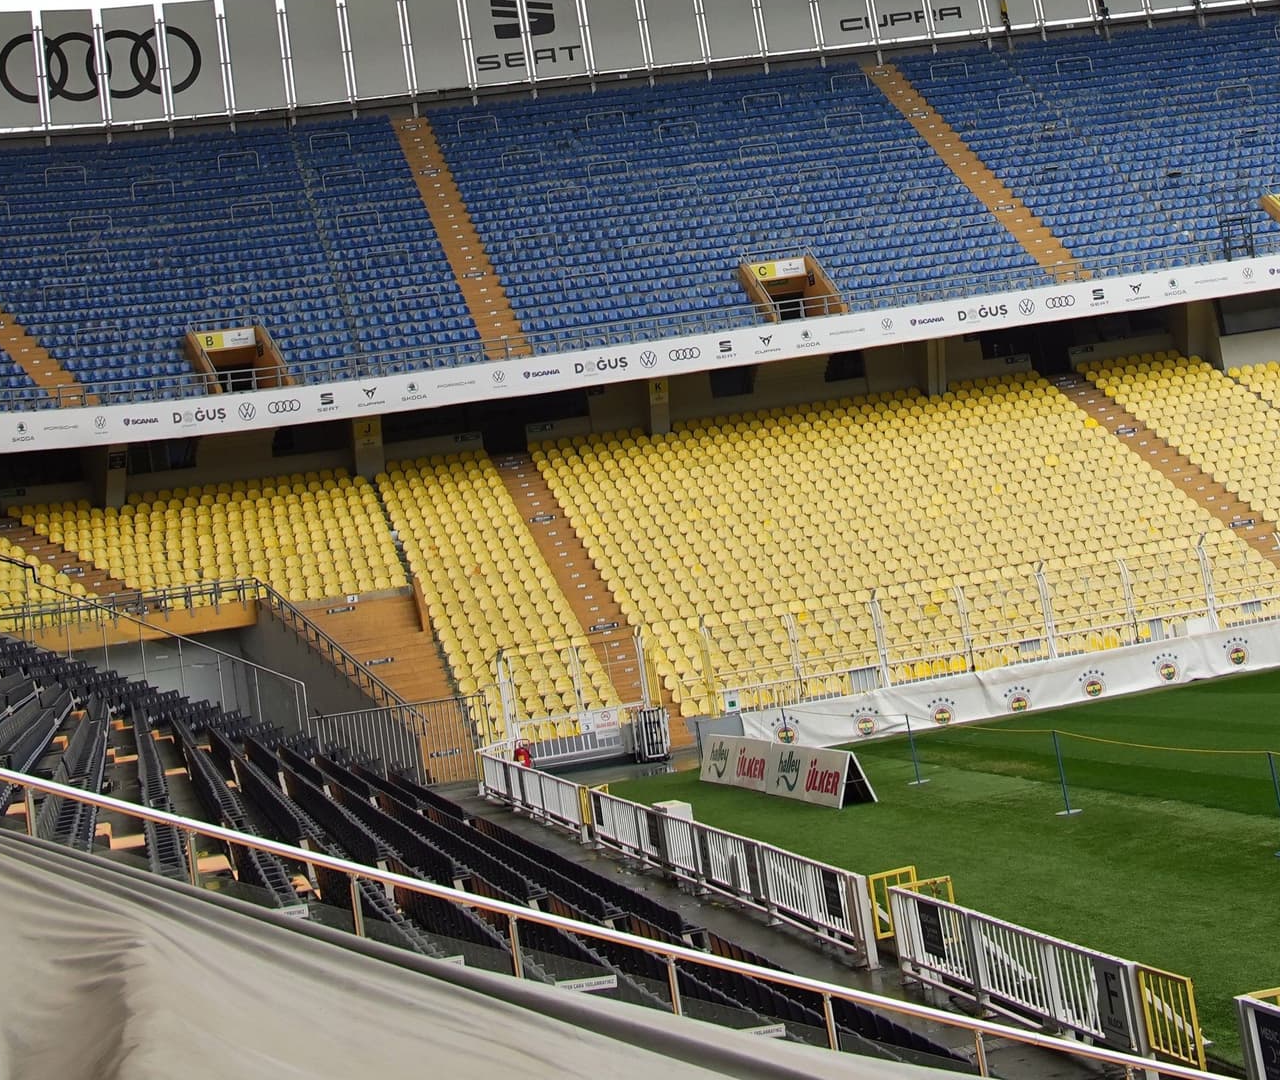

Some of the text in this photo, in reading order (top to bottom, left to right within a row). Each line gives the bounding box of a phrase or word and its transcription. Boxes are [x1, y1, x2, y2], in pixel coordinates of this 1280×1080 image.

[840, 6, 962, 31] CUPRA
[476, 45, 581, 71] SEAT
[759, 267, 767, 276] C
[206, 336, 214, 347] B
[532, 369, 560, 378] SCANIA
[655, 382, 662, 391] K
[710, 741, 840, 796] halley ÜLKER halley ÜLKER
[1104, 971, 1118, 1014] F
